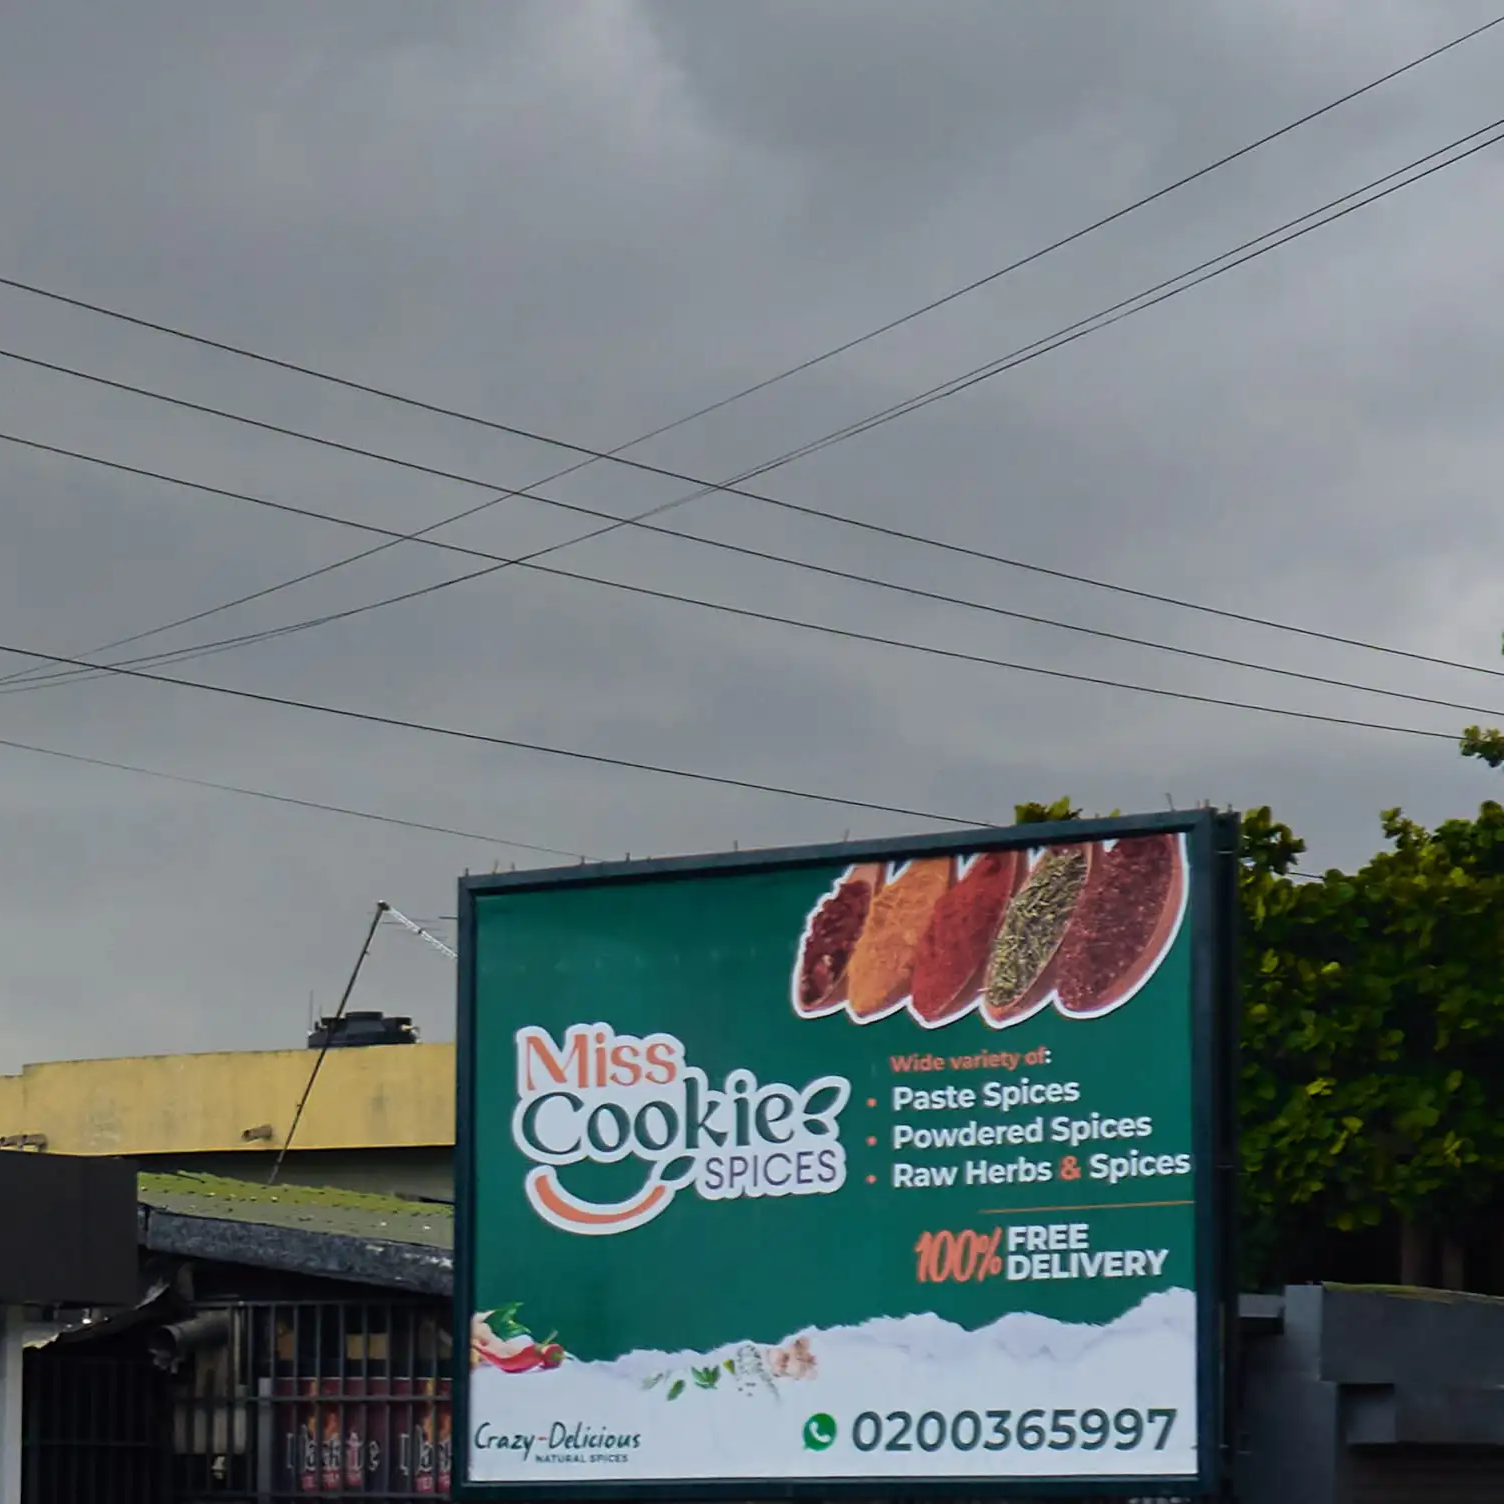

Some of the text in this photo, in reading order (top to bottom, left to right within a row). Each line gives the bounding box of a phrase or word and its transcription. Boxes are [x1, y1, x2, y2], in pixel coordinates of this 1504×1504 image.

[524, 1031, 677, 1091] Miss
[890, 1046, 1052, 1073] Wide variety of:
[893, 1077, 1080, 1112] Paste Spices
[521, 1077, 795, 1156] Cookie
[894, 1112, 1152, 1149] Powdered Spices
[704, 1149, 838, 1190] SPICES
[894, 1150, 1192, 1188] Raw Herbs & Spices
[914, 1226, 1003, 1283] 100%
[1007, 1223, 1090, 1251] FREE
[1006, 1248, 1169, 1281] DELIVERY
[474, 1421, 641, 1461] Crazy-Delicious
[851, 1407, 1178, 1453] 0200365997
[535, 1453, 629, 1463] NATURAL SPICES
